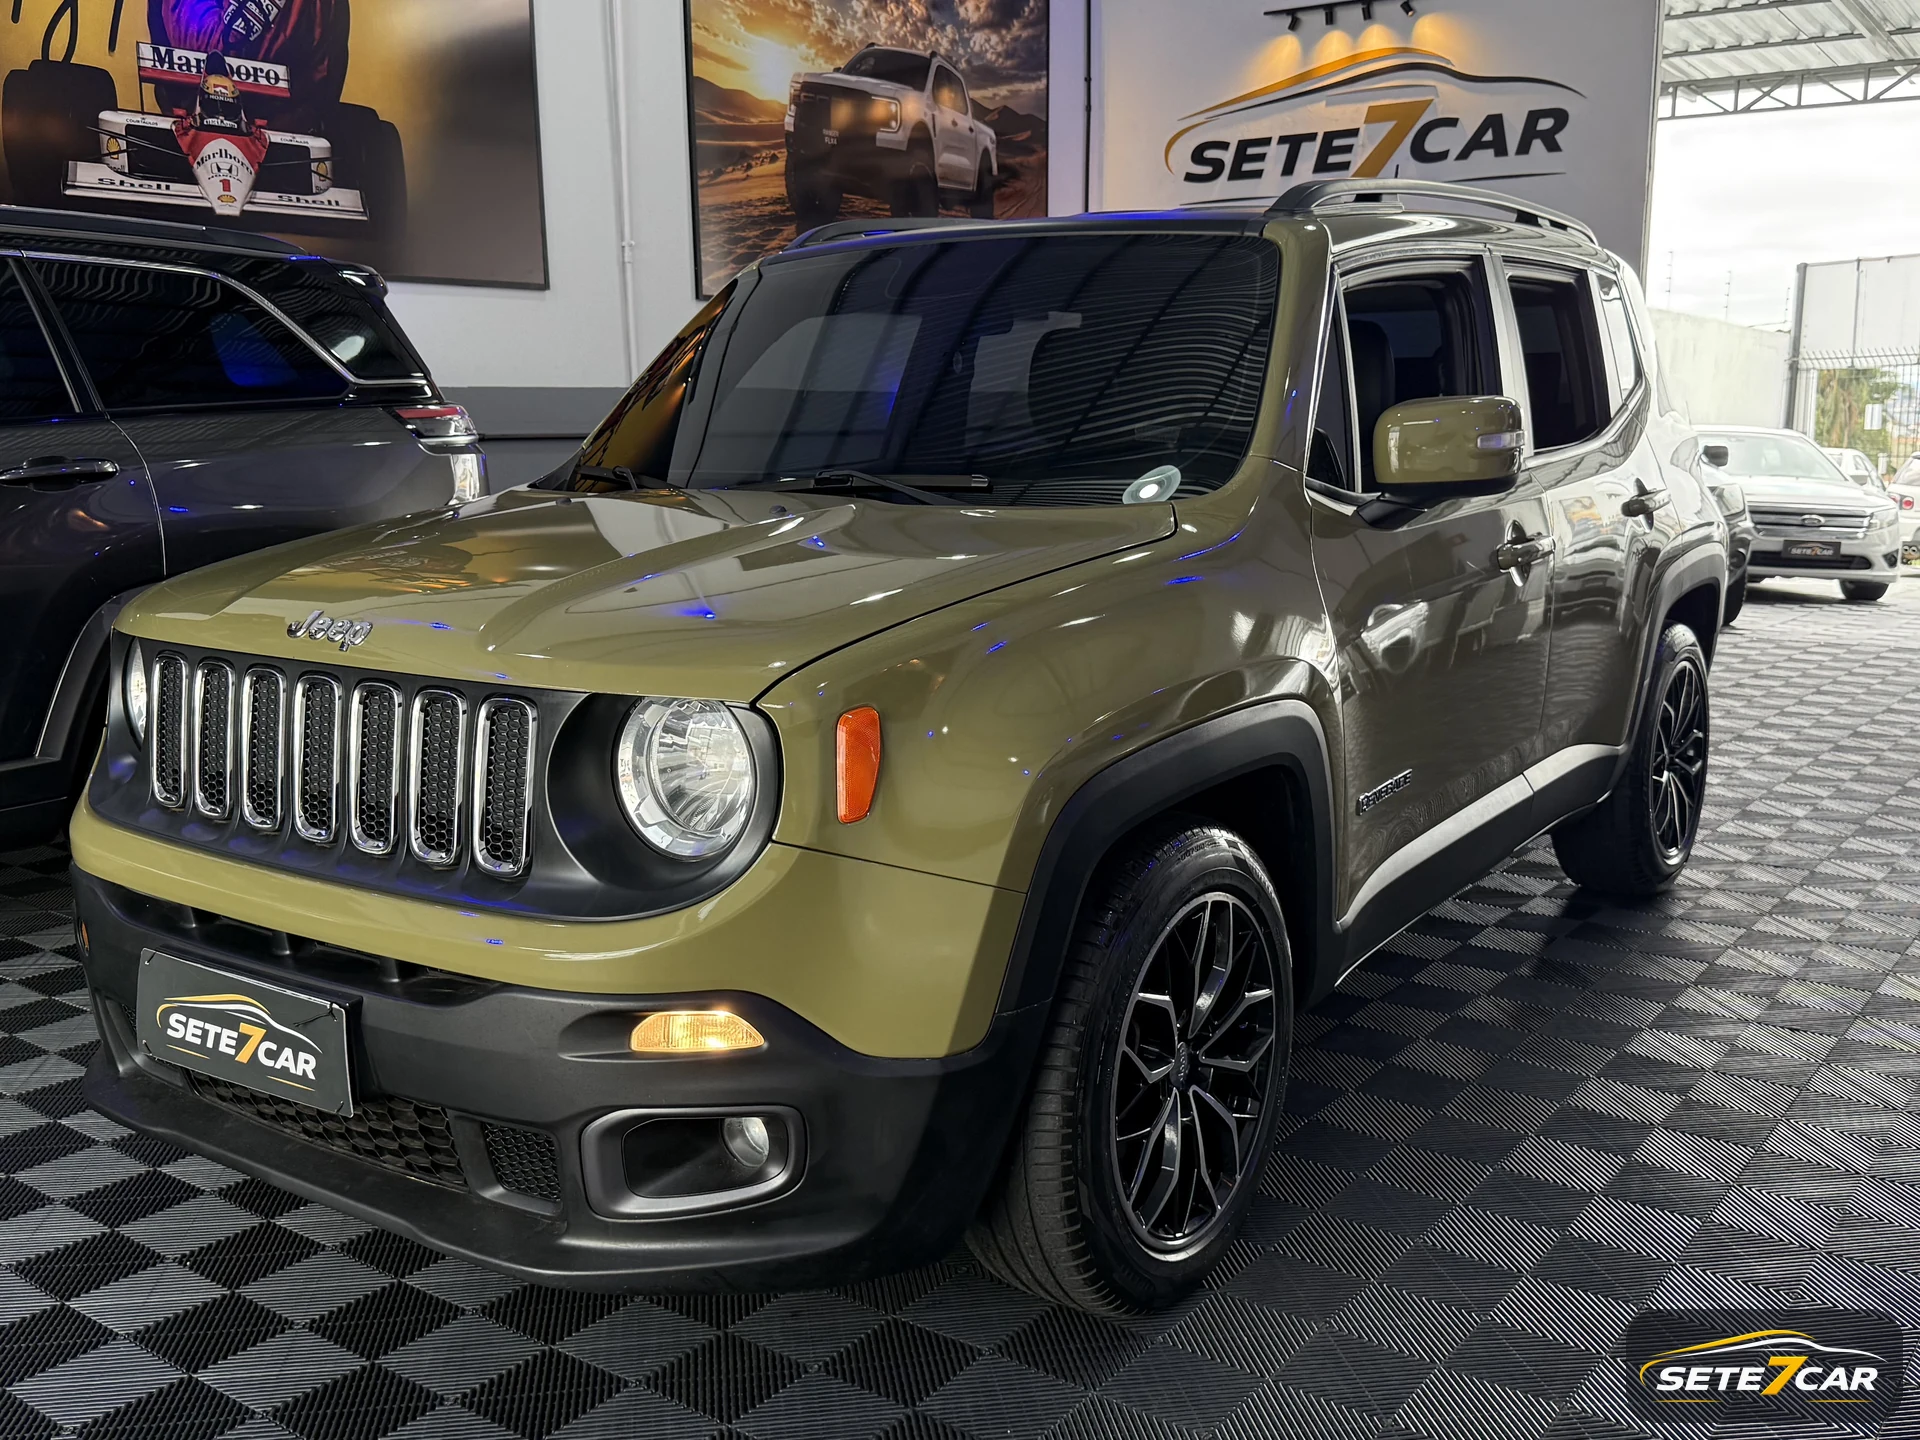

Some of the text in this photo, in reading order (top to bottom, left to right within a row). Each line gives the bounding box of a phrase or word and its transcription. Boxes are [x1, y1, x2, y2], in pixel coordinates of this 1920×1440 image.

[150, 45, 281, 85] Maroro
[1183, 98, 1570, 184] SETE7CAR
[196, 148, 253, 176] Marlboro
[97, 178, 171, 191] Shell
[219, 178, 231, 193] 1
[277, 195, 340, 207] Shell
[286, 609, 374, 653] Jeep
[166, 1012, 317, 1081] SETE7CAR
